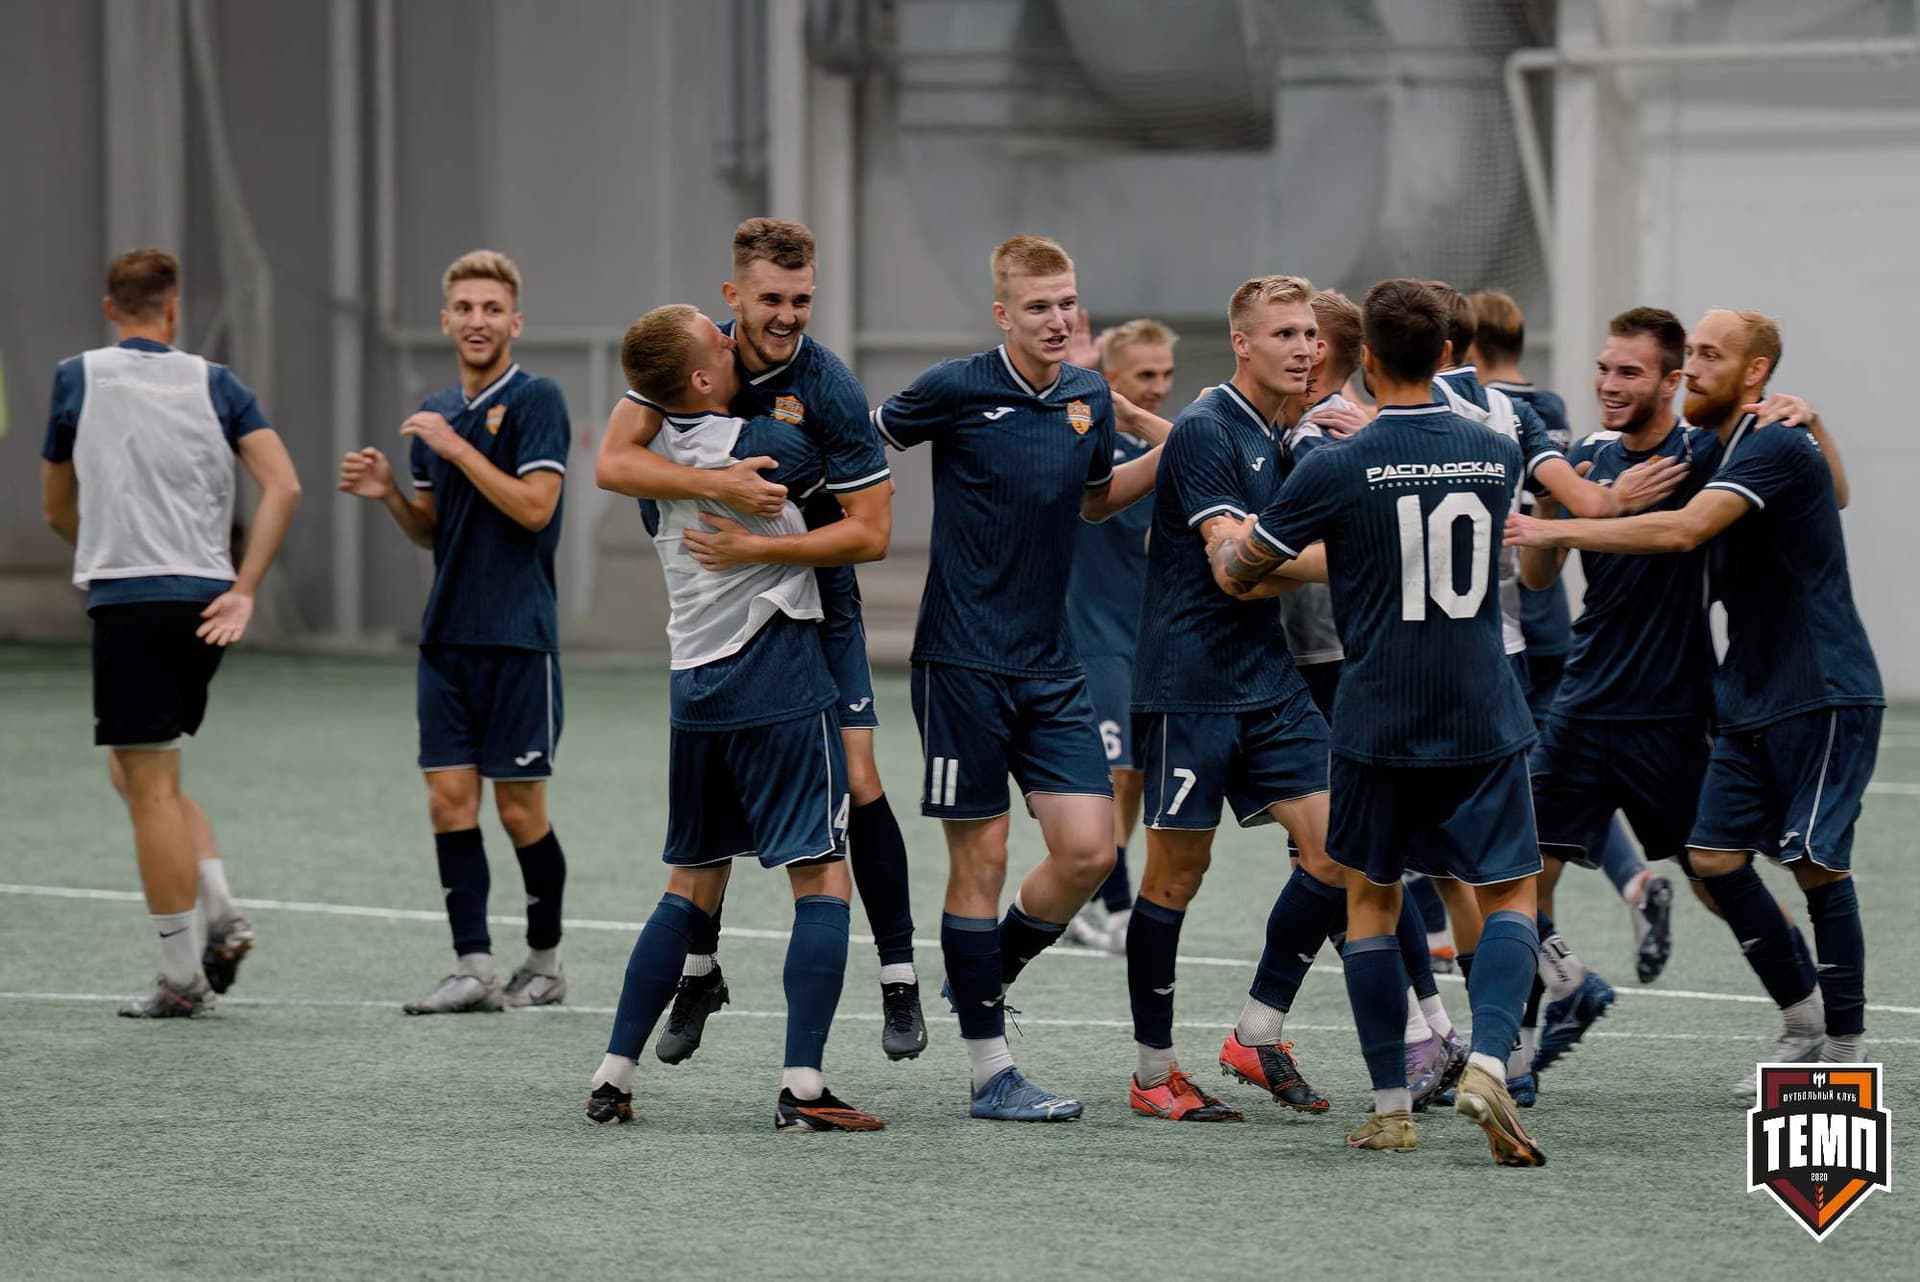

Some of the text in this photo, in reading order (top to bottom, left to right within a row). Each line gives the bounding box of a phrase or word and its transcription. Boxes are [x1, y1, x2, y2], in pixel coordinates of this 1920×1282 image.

[1396, 491, 1492, 621] 10
[1100, 720, 1123, 760] 6
[931, 756, 959, 806] 11
[1166, 767, 1197, 815] 7
[833, 793, 850, 841] 4
